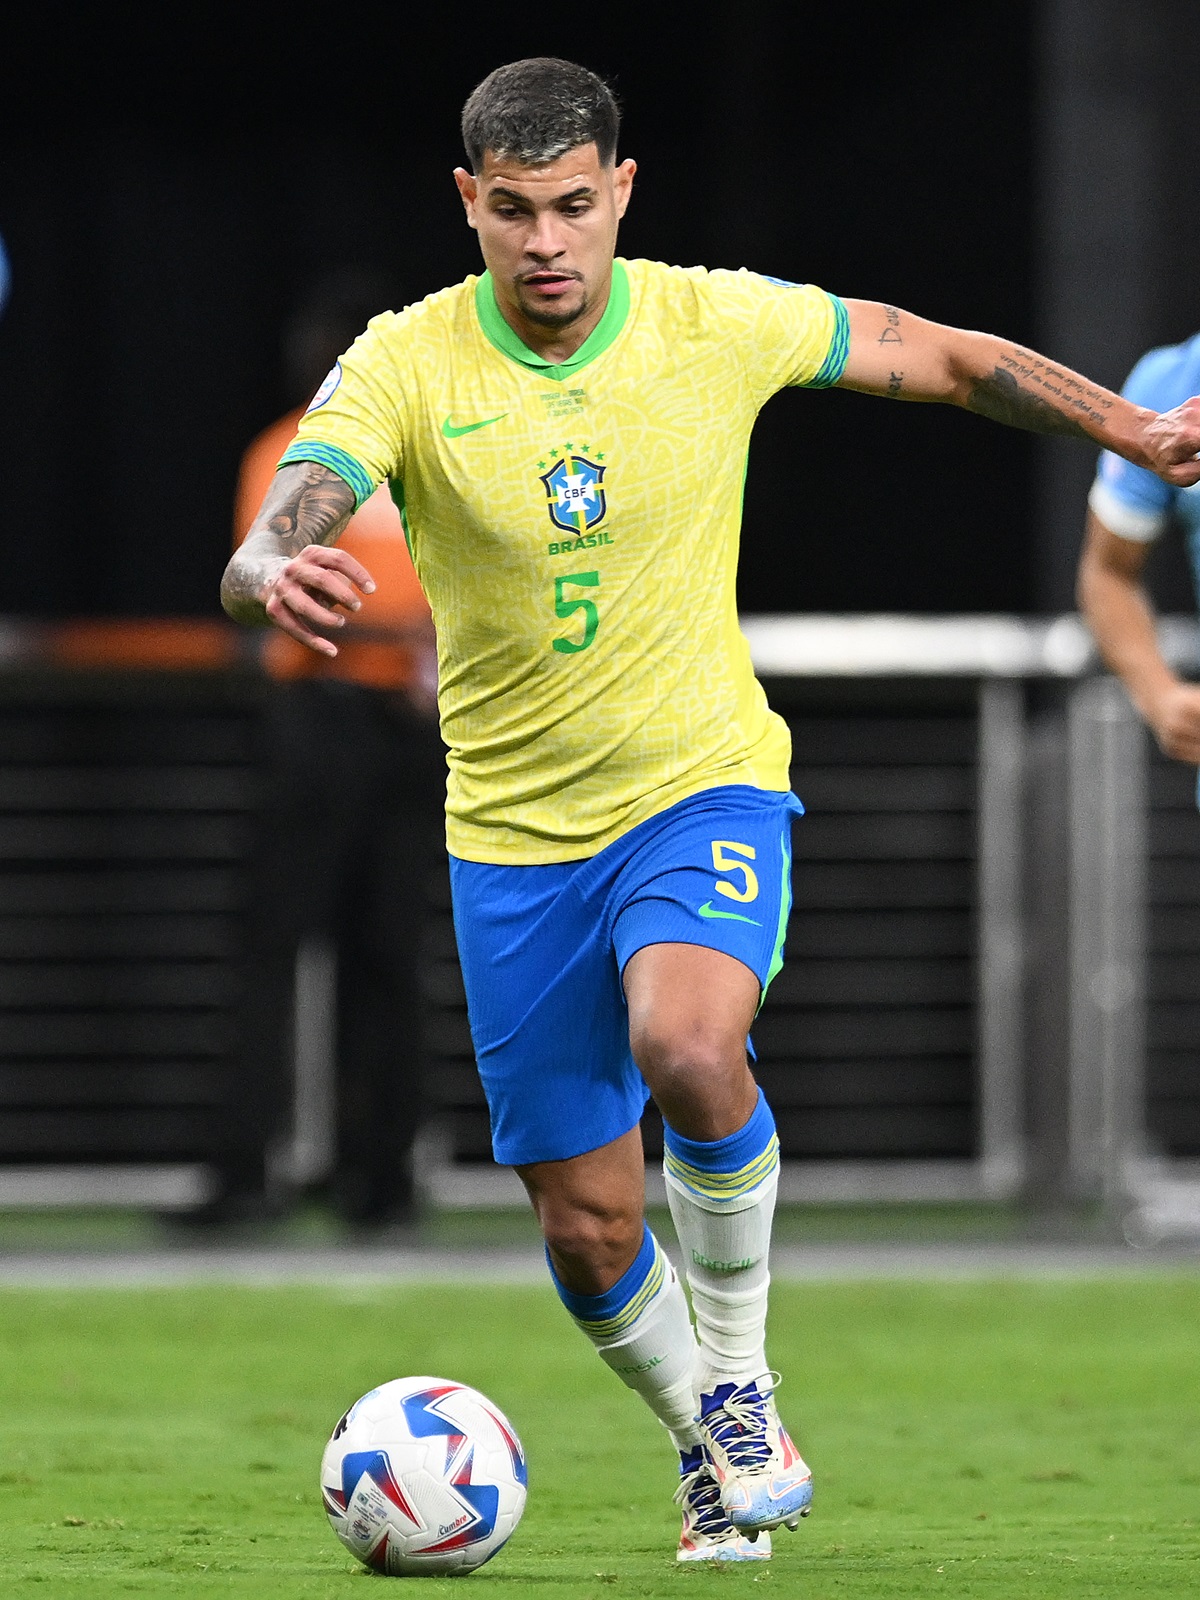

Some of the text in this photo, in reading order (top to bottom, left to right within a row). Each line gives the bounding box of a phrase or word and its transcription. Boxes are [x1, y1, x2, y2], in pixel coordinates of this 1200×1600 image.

[564, 487, 586, 499] CBF
[548, 532, 615, 555] BRASIL
[552, 570, 600, 654] 5
[711, 840, 759, 903] 5
[438, 1514, 467, 1537] Cumbre
